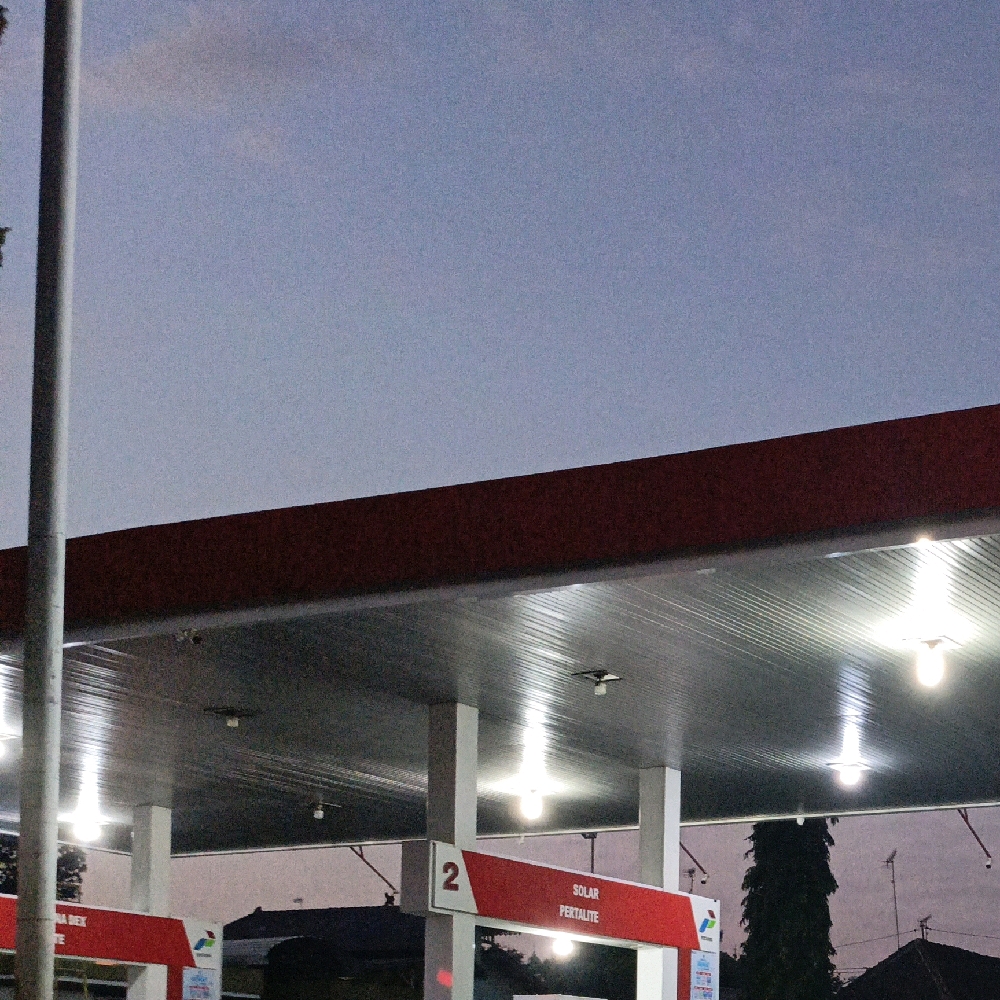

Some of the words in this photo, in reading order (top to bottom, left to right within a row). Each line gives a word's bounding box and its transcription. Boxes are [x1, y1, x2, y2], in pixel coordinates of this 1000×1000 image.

[442, 861, 459, 892] 2
[572, 883, 600, 901] SOLAR
[559, 904, 599, 924] PERTALITE
